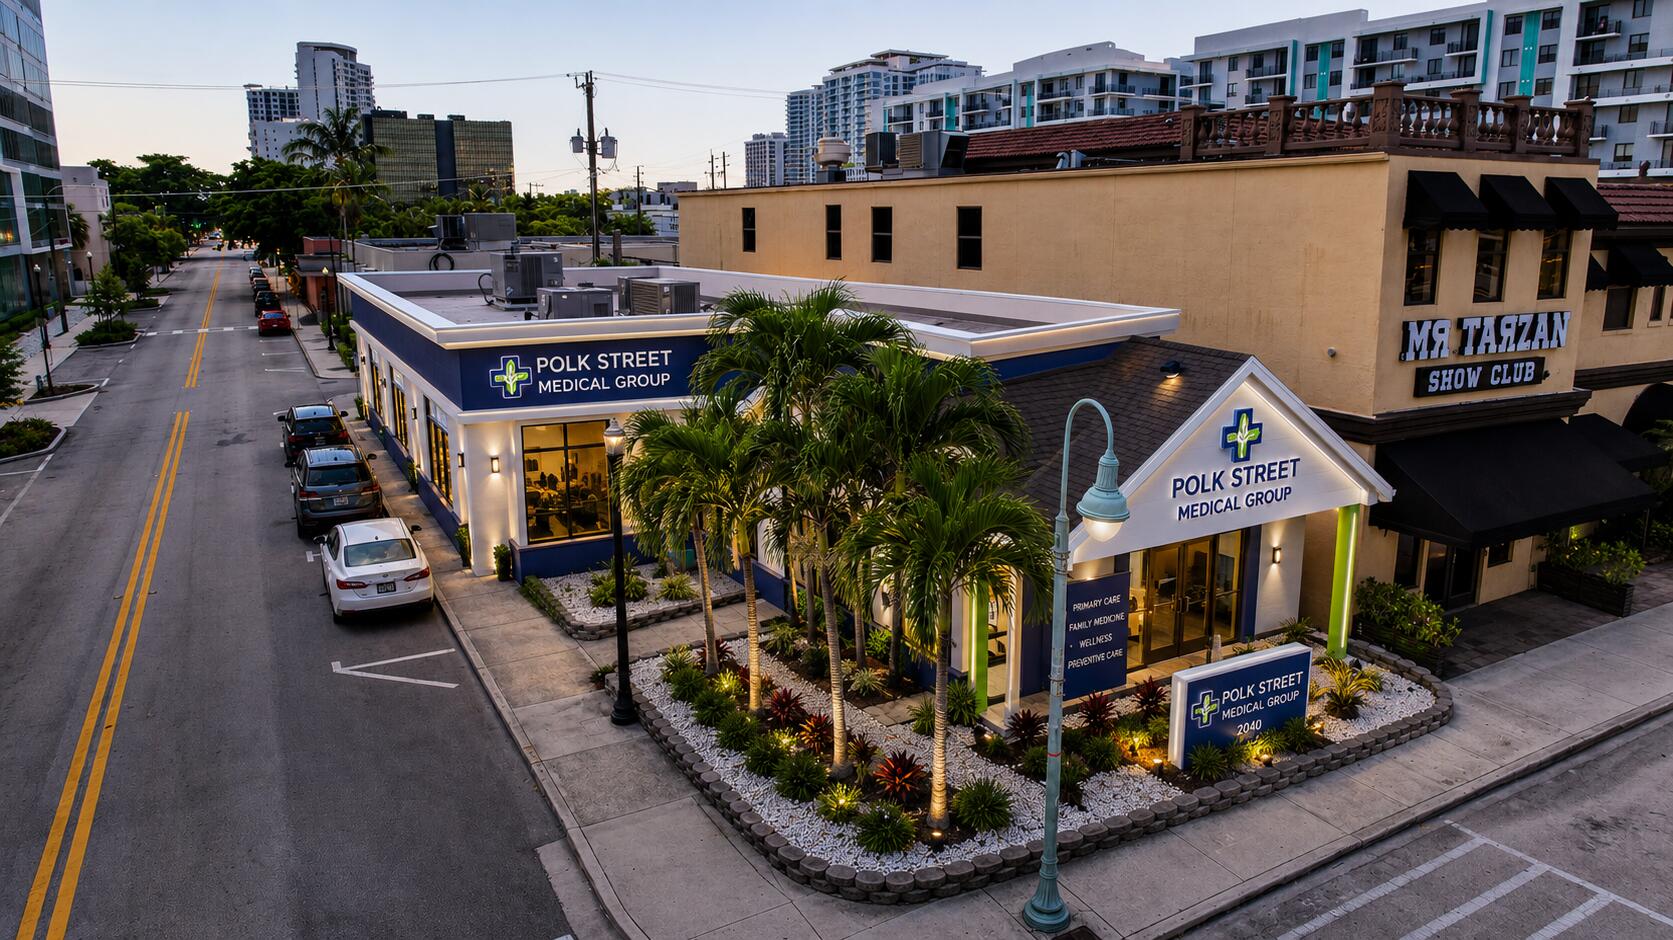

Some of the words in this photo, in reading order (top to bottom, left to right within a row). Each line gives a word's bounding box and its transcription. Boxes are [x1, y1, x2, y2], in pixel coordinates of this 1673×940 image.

[536, 354, 591, 373] POLK
[598, 350, 672, 370] STREET
[538, 377, 611, 394] MEDICAL
[615, 373, 671, 389] GROUP
[1427, 367, 1482, 392] SHOW
[1490, 361, 1536, 385] CLUB
[1171, 470, 1225, 498] POLK
[1230, 457, 1301, 488] STREET
[1178, 496, 1241, 521] MEDICAL
[1245, 486, 1292, 508] GROUP
[1073, 599, 1103, 612] PRIMARY
[1103, 594, 1121, 606] CARE
[1069, 620, 1092, 632] FAMILY
[1079, 633, 1113, 649] WELLNESS
[1068, 652, 1105, 669] PREVENTIVE
[1106, 648, 1123, 660] CARE
[1222, 684, 1256, 704] POLK
[1258, 671, 1304, 695] STREET
[1222, 700, 1265, 720] MEDICAL
[1267, 690, 1300, 707] GROUP
[1236, 719, 1262, 736] 2040
